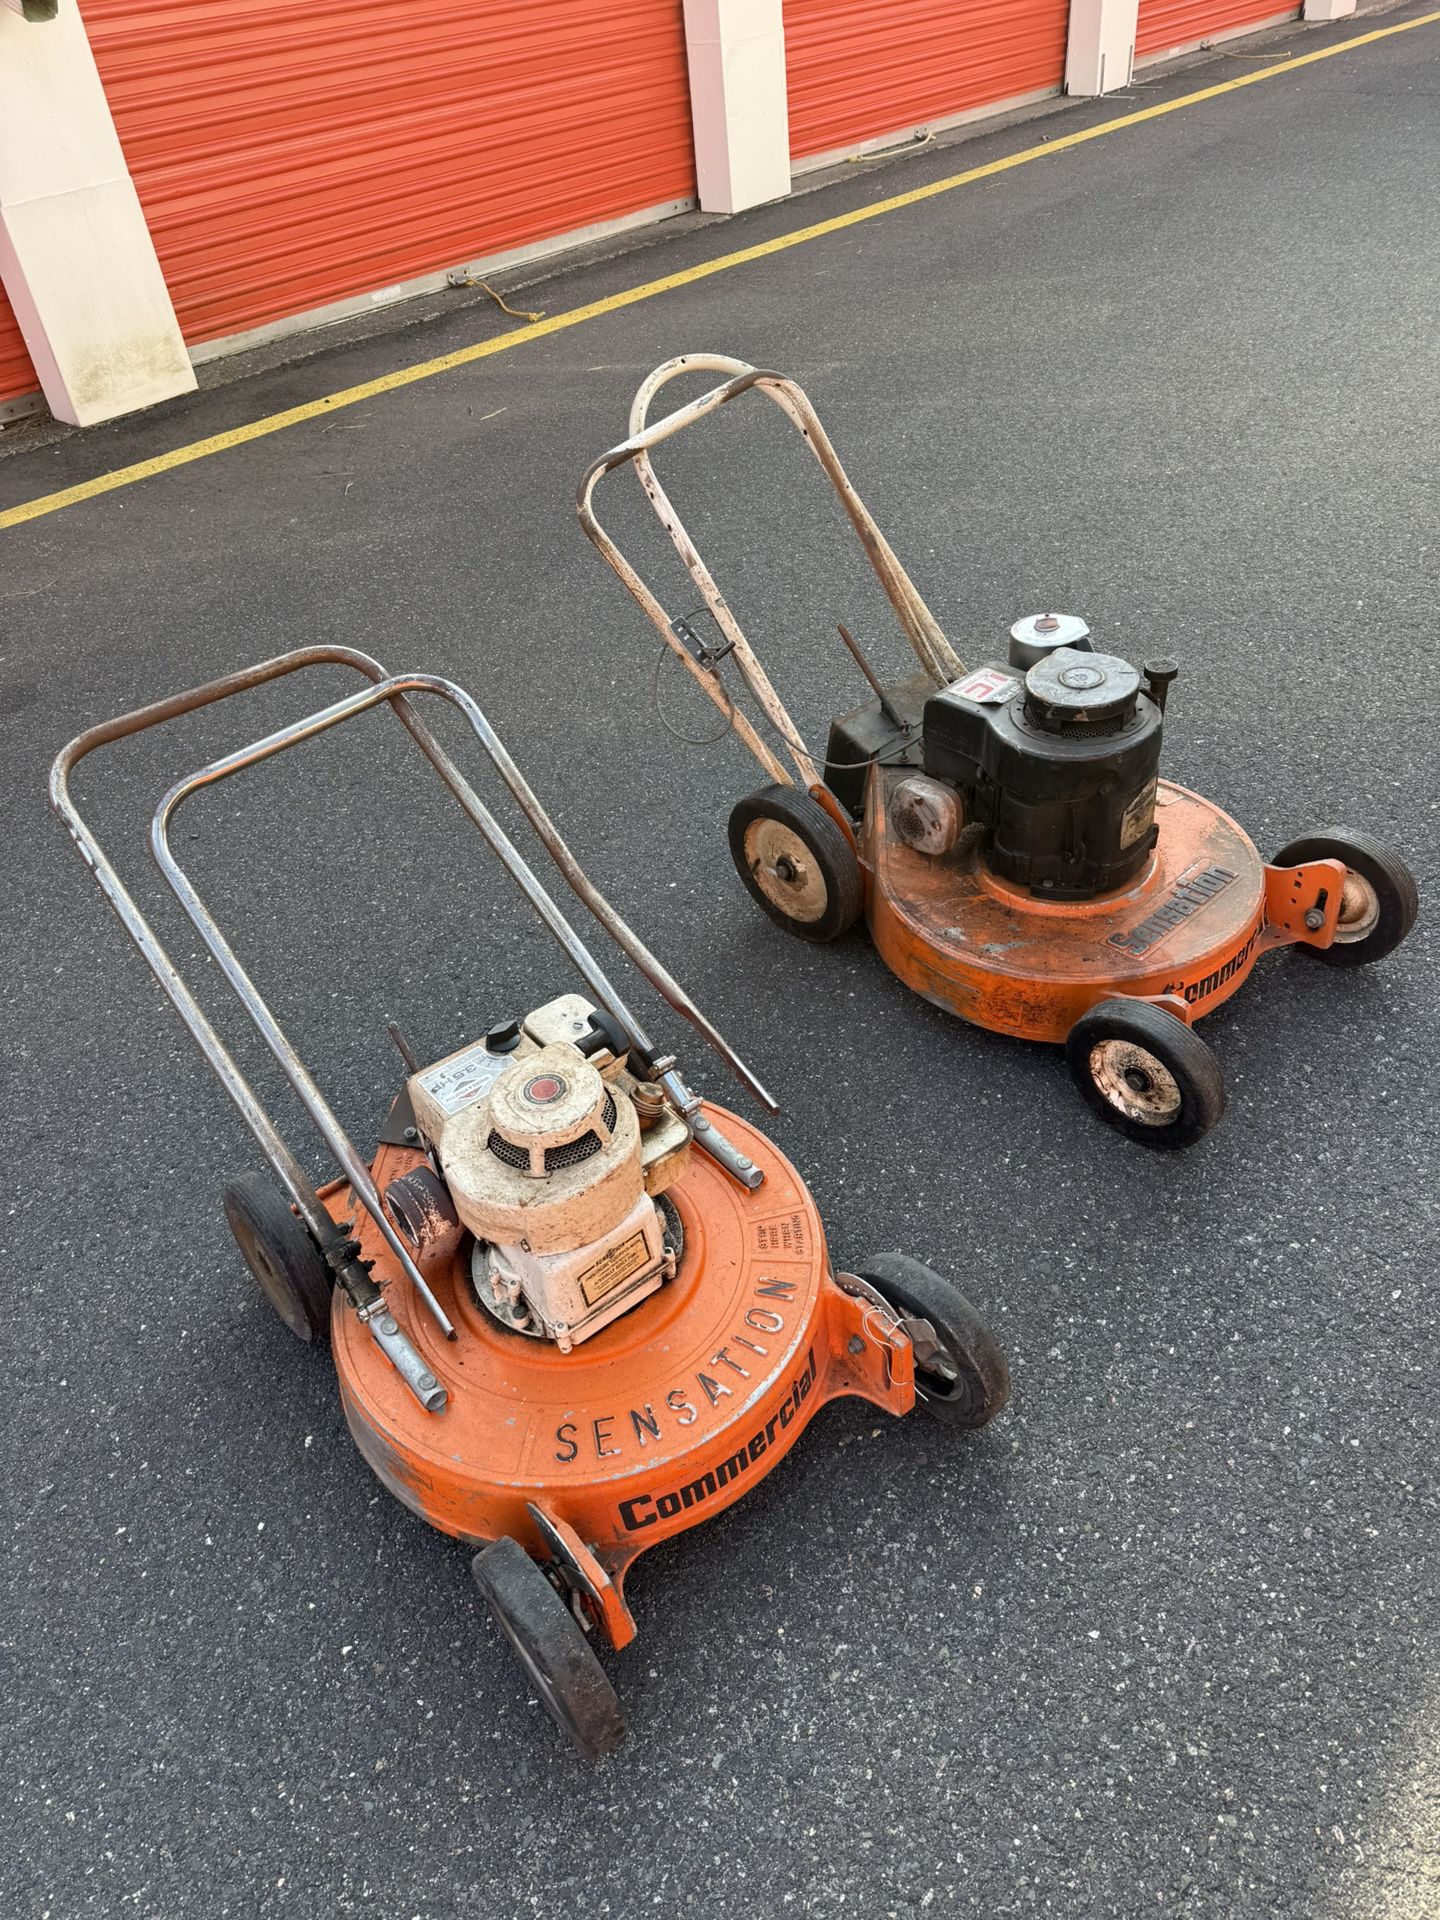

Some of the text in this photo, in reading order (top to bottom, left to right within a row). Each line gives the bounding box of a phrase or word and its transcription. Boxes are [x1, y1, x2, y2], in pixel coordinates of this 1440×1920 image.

[1106, 863, 1239, 956] Sensation
[553, 1275, 799, 1464] SENSATION
[617, 1347, 817, 1531] Commercial
